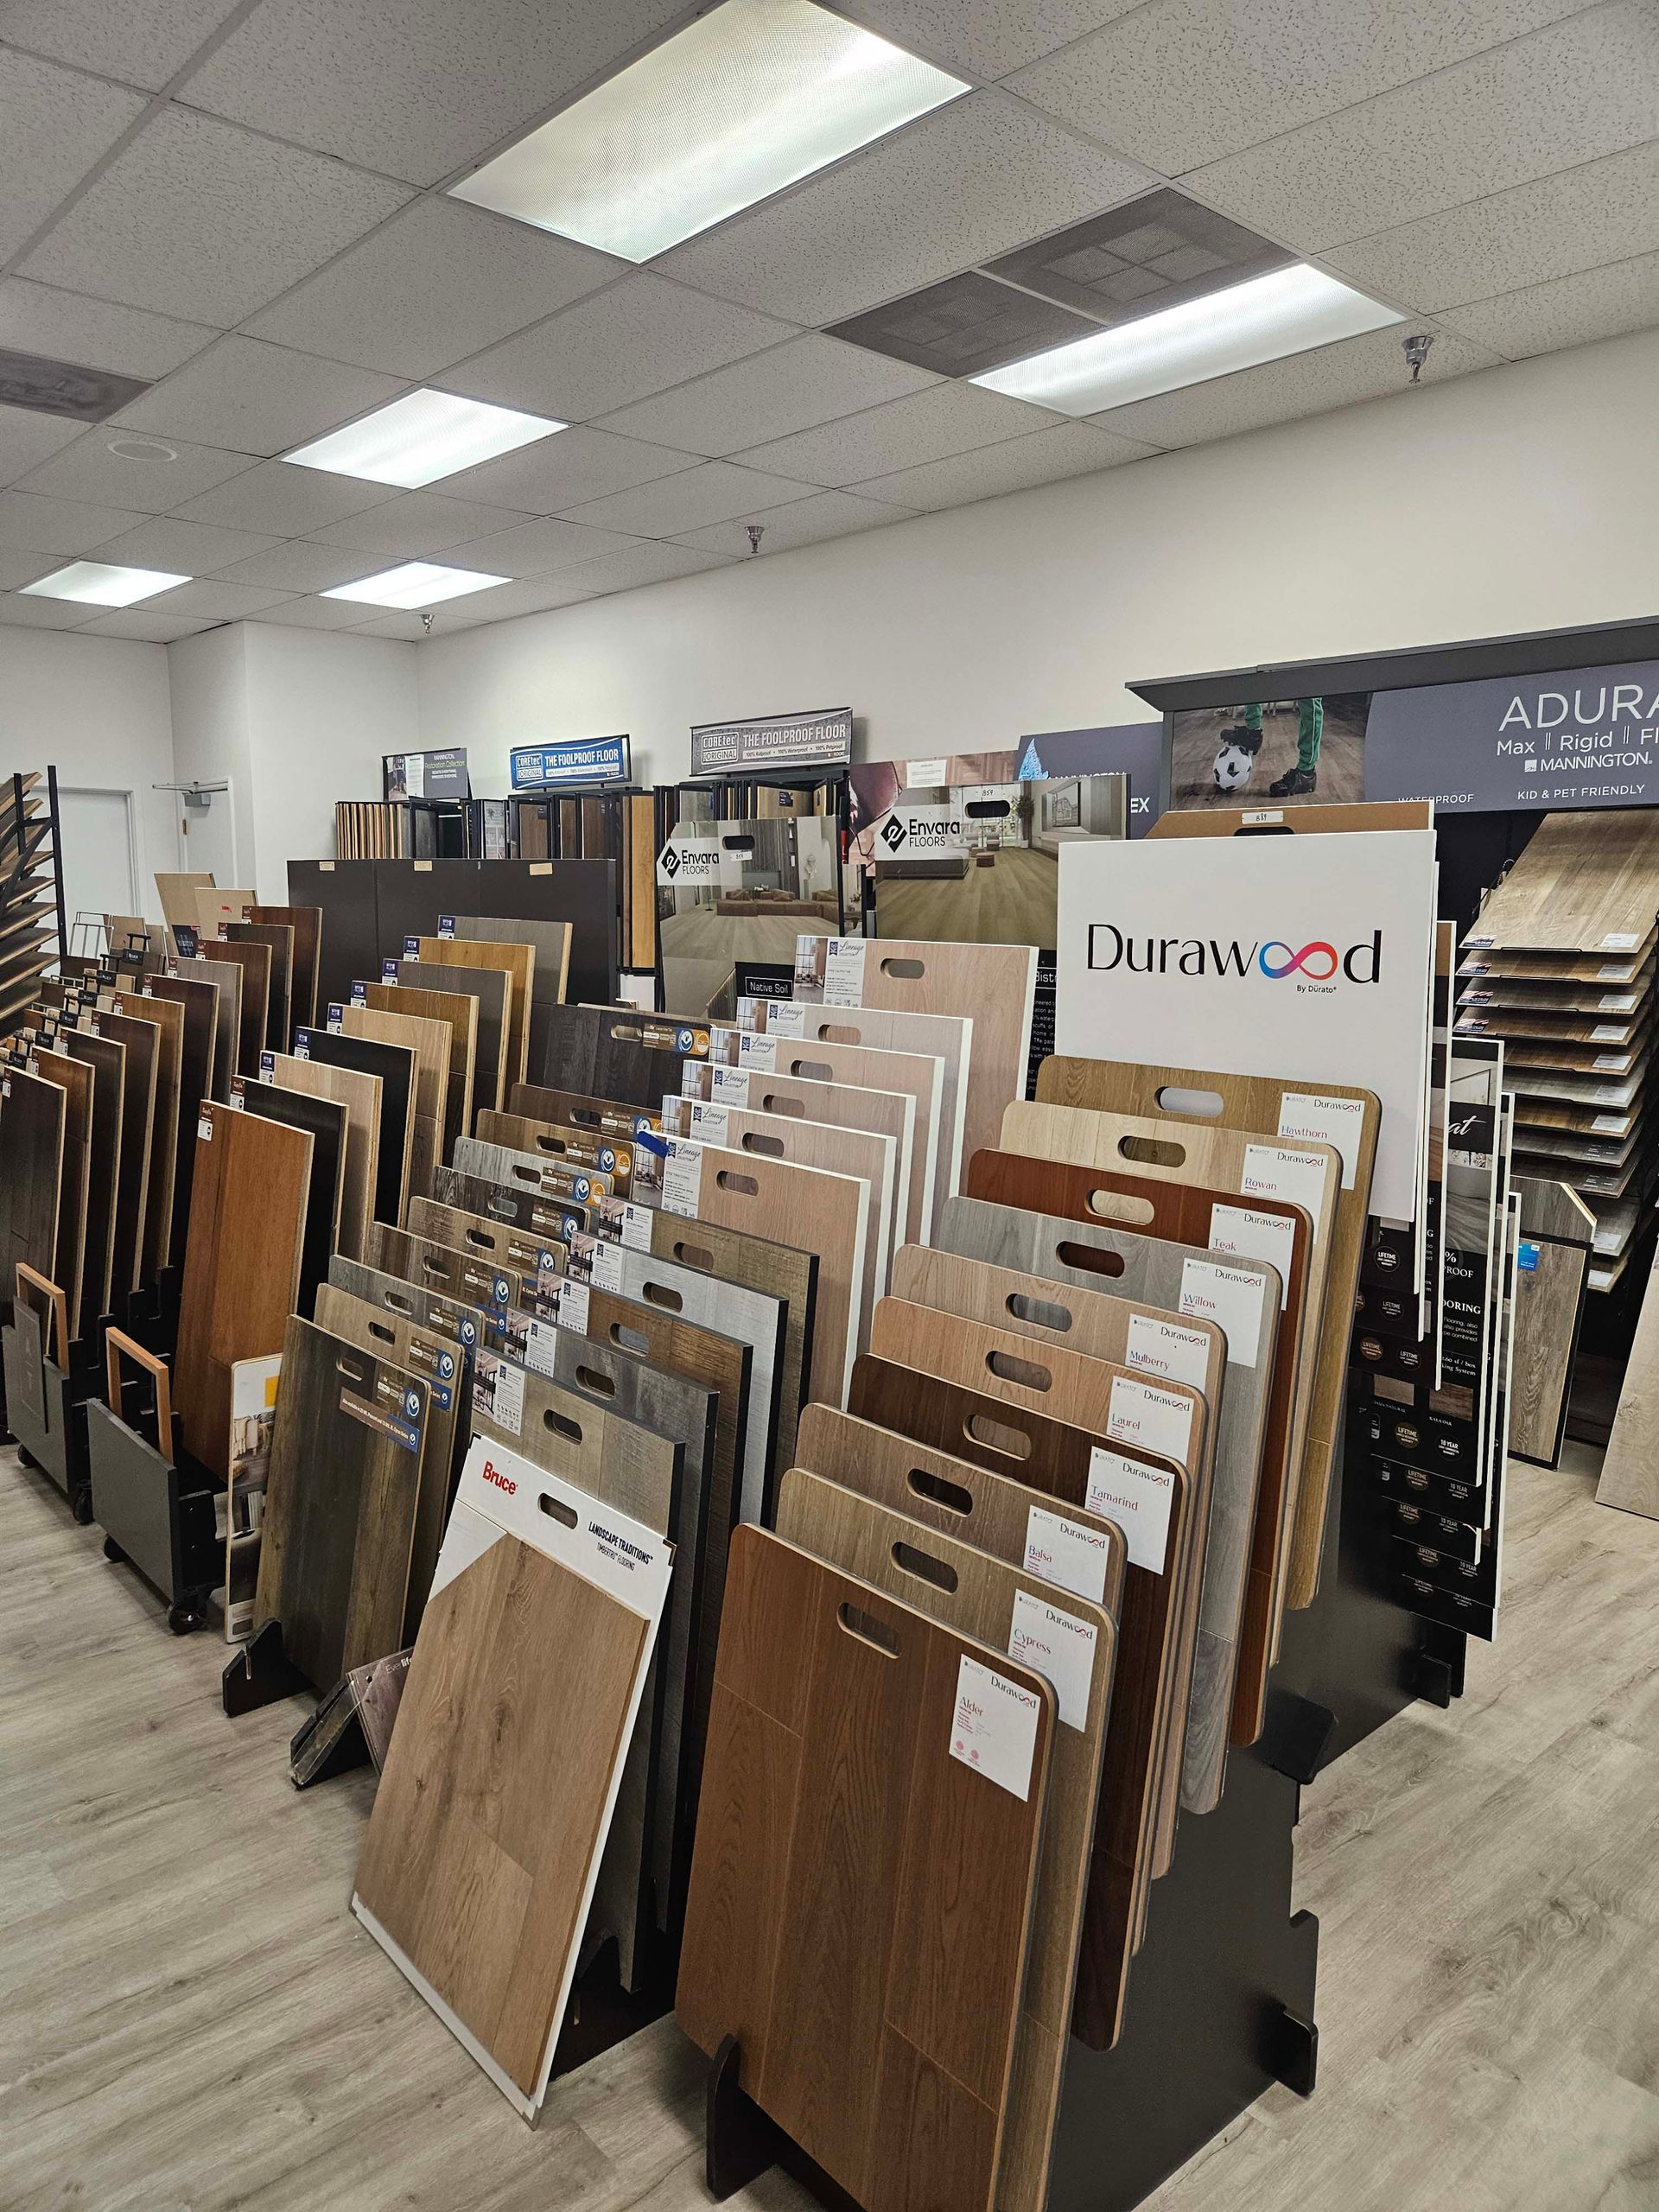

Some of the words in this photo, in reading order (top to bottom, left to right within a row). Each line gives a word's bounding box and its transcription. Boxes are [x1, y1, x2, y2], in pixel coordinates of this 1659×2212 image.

[703, 735, 735, 748] COREtec
[743, 734, 759, 747] THE
[761, 728, 813, 746] FOOLPROOF
[816, 724, 846, 740] FLOOR
[1497, 741, 1535, 756] Max
[1560, 731, 1612, 752] Rigid
[518, 756, 541, 767] COREtec
[545, 755, 557, 767] THE
[558, 752, 595, 766] FOOLPROOF
[597, 748, 619, 761] FLOOR
[706, 750, 736, 760] ORIGINAL
[1541, 751, 1649, 771] MANNINGTON
[519, 769, 542, 778] ORIGINAL
[1517, 790, 1538, 800] KID
[1541, 790, 1549, 799] &
[1554, 788, 1577, 798] PET
[1581, 784, 1645, 797] FRIENDLY
[910, 819, 960, 836] Envara
[910, 836, 945, 847] FLOORS
[682, 850, 719, 864] Envara
[682, 866, 709, 874] FLOORS
[1087, 924, 1382, 983] Durawood
[750, 982, 772, 993] Native
[774, 984, 788, 994] Soil
[1281, 1125, 1328, 1139] Hawthorn
[1245, 1177, 1277, 1191] Rowan
[1213, 1238, 1236, 1251] Teak
[1184, 1294, 1217, 1309] Willow
[1130, 1351, 1170, 1372] Mulberry
[1112, 1413, 1141, 1430] Laurel
[1397, 1427, 1417, 1437] LIFETIME
[483, 1461, 517, 1495] Bruce
[1091, 1484, 1138, 1510] Tamarind
[588, 1522, 619, 1547] LANDSCAPE
[618, 1538, 651, 1565] TRADITIONS
[1029, 1545, 1052, 1562] Balsa
[617, 1554, 635, 1571] FLOORING
[1014, 1628, 1052, 1655] Cypress
[960, 1696, 984, 1717] Alder
